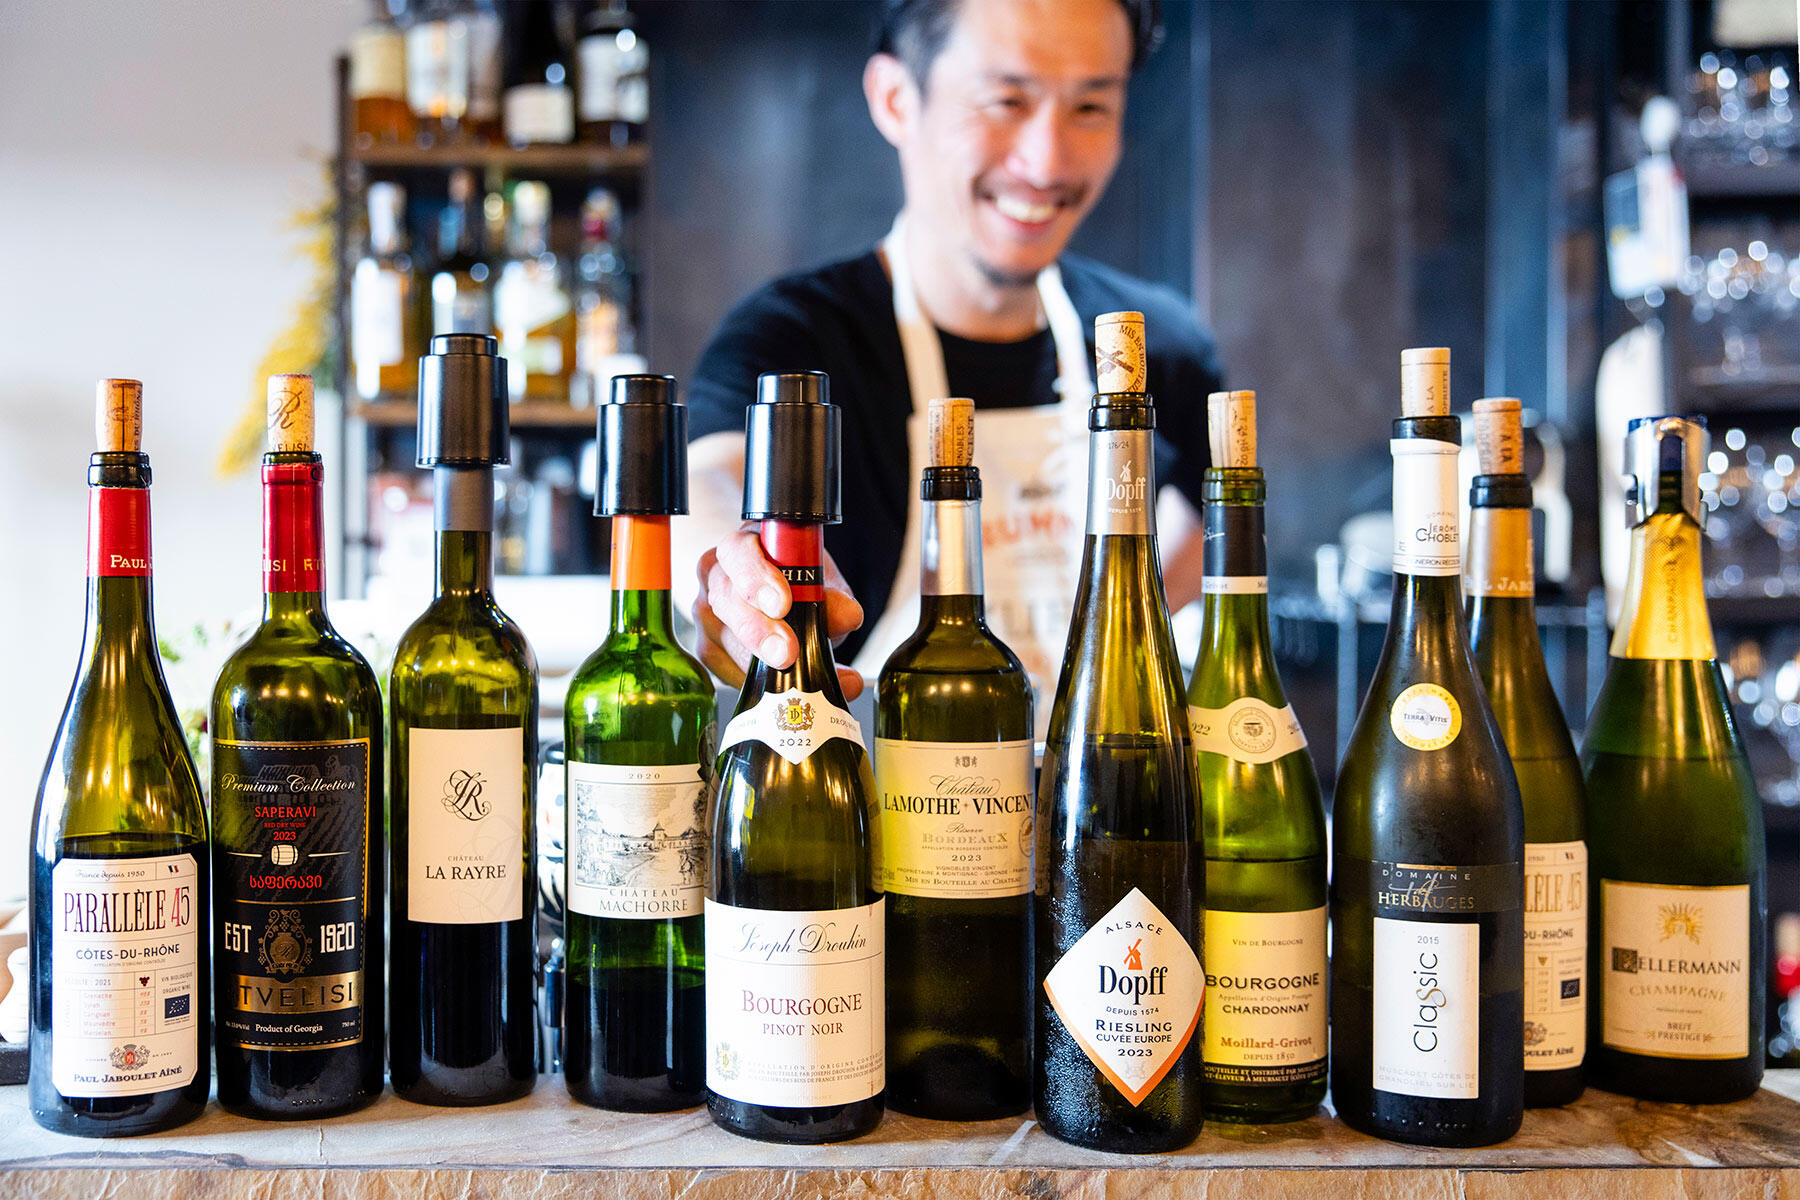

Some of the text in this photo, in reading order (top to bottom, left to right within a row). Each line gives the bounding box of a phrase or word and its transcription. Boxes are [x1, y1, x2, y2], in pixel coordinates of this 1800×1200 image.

[1104, 476, 1146, 507] Dopff
[110, 555, 147, 568] PAUL
[1404, 713, 1425, 721] TERRA
[779, 738, 812, 747] 2022
[221, 773, 356, 792] Premium Collection
[929, 774, 1001, 797] Château
[884, 792, 960, 815] LAMOTHE
[254, 806, 317, 818] SAPERAVI
[272, 832, 297, 841] 2023
[922, 832, 1008, 844] BORDEAUX
[952, 854, 982, 862] 2023
[426, 864, 506, 880] LA RAYRE
[1382, 870, 1472, 881] DOMAINE
[250, 874, 323, 890] საფერავი
[933, 878, 977, 886] BOUTEILLE
[600, 899, 688, 913] MACHORRE
[1378, 892, 1475, 910] HERBAUGES
[64, 886, 190, 934] PARALLÈLE 45
[1105, 920, 1164, 936] ALSACE
[224, 921, 356, 954] EST 1920
[738, 922, 867, 961] Joseph Drouhin
[1416, 936, 1440, 945] 2015
[76, 943, 180, 960] CÔTES-DU-RHÔNE
[1098, 964, 1168, 1006] Dopff
[1205, 972, 1320, 990] BOURGOGNE
[1628, 984, 1728, 1001] CHAMPAGNE
[742, 988, 863, 1016] BOURGOGNE
[1222, 1002, 1310, 1015] CHARDONNAY
[1413, 952, 1446, 1052] Classic
[1106, 1006, 1160, 1016] DEPUIS 1574
[255, 1024, 283, 1032] Product
[284, 1024, 294, 1032] of
[294, 1024, 323, 1034] Georgia
[762, 1022, 844, 1036] PINOT NOIR
[1096, 1019, 1173, 1033] RIESLING
[1096, 1033, 1172, 1044] CUVÉE EUROPE
[1220, 1036, 1312, 1049] Moillard-Grivot
[1657, 1030, 1701, 1042] PRESTIGE
[1118, 1048, 1154, 1057] 2023
[1243, 1052, 1274, 1060] DEPUIS
[74, 1066, 183, 1084] PAUL JABOULET AÎNÉ
[1436, 1080, 1456, 1088] SUR
